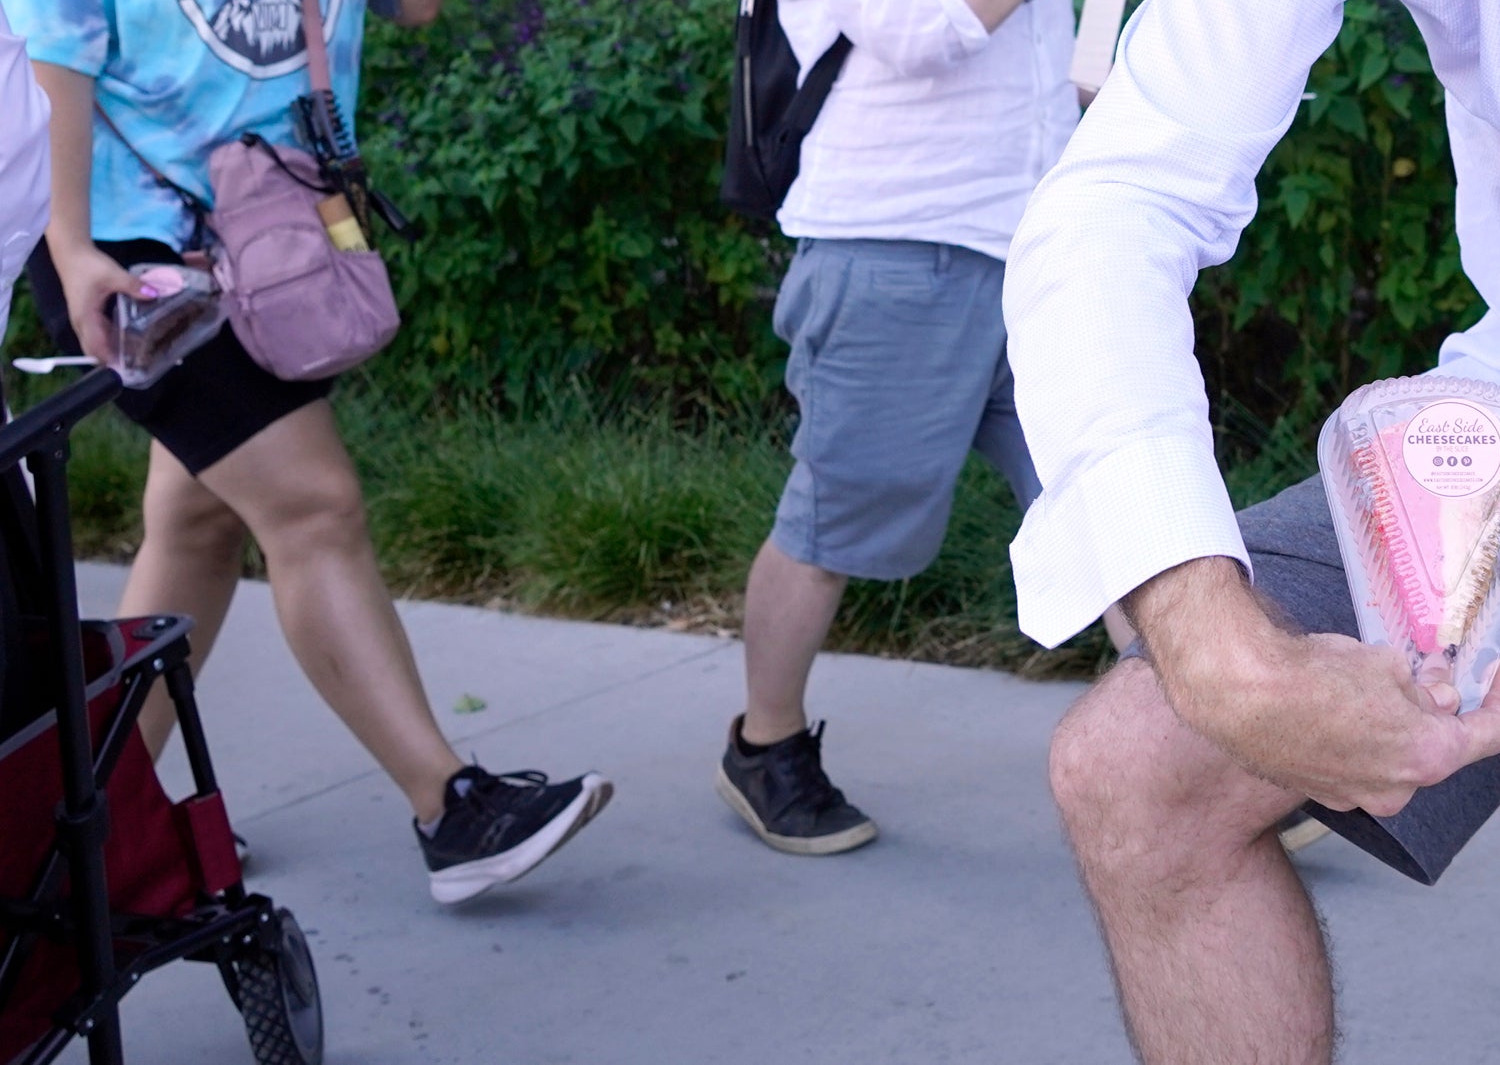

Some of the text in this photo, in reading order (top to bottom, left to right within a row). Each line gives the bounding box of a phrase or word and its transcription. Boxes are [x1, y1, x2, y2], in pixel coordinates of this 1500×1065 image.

[1418, 417, 1484, 434] East Side
[1407, 435, 1497, 445] CHEESECAKES
